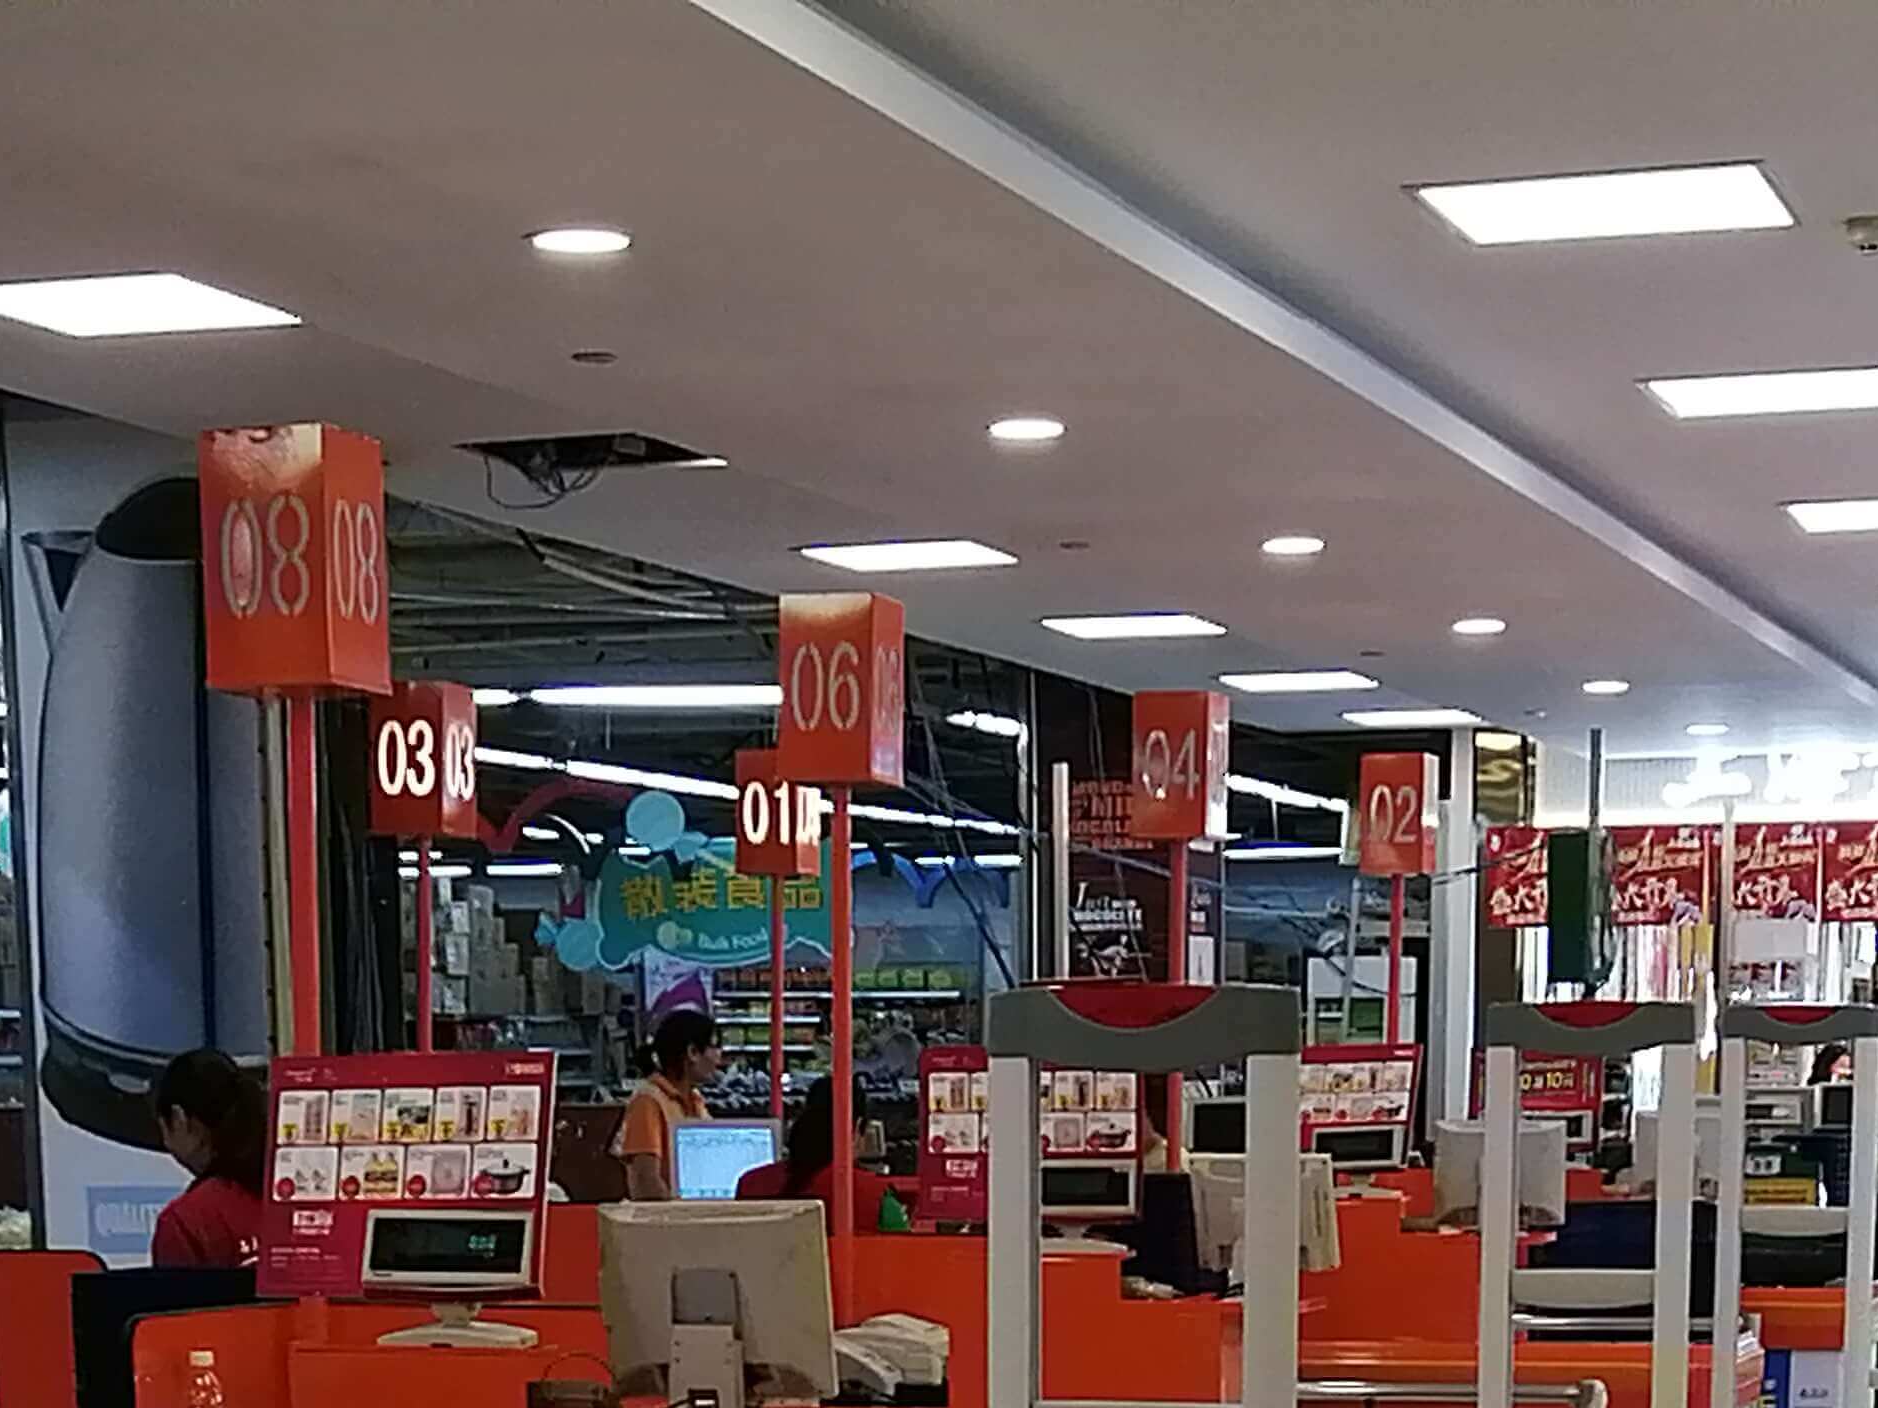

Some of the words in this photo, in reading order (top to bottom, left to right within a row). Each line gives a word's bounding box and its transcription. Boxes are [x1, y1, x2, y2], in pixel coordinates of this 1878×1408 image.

[221, 495, 312, 618] 08
[332, 498, 380, 625] 08
[791, 641, 860, 731] 06
[377, 718, 436, 797] 03
[444, 721, 475, 802] 03
[1142, 729, 1200, 799] 04
[742, 780, 790, 846] 01
[1370, 784, 1417, 843] 02
